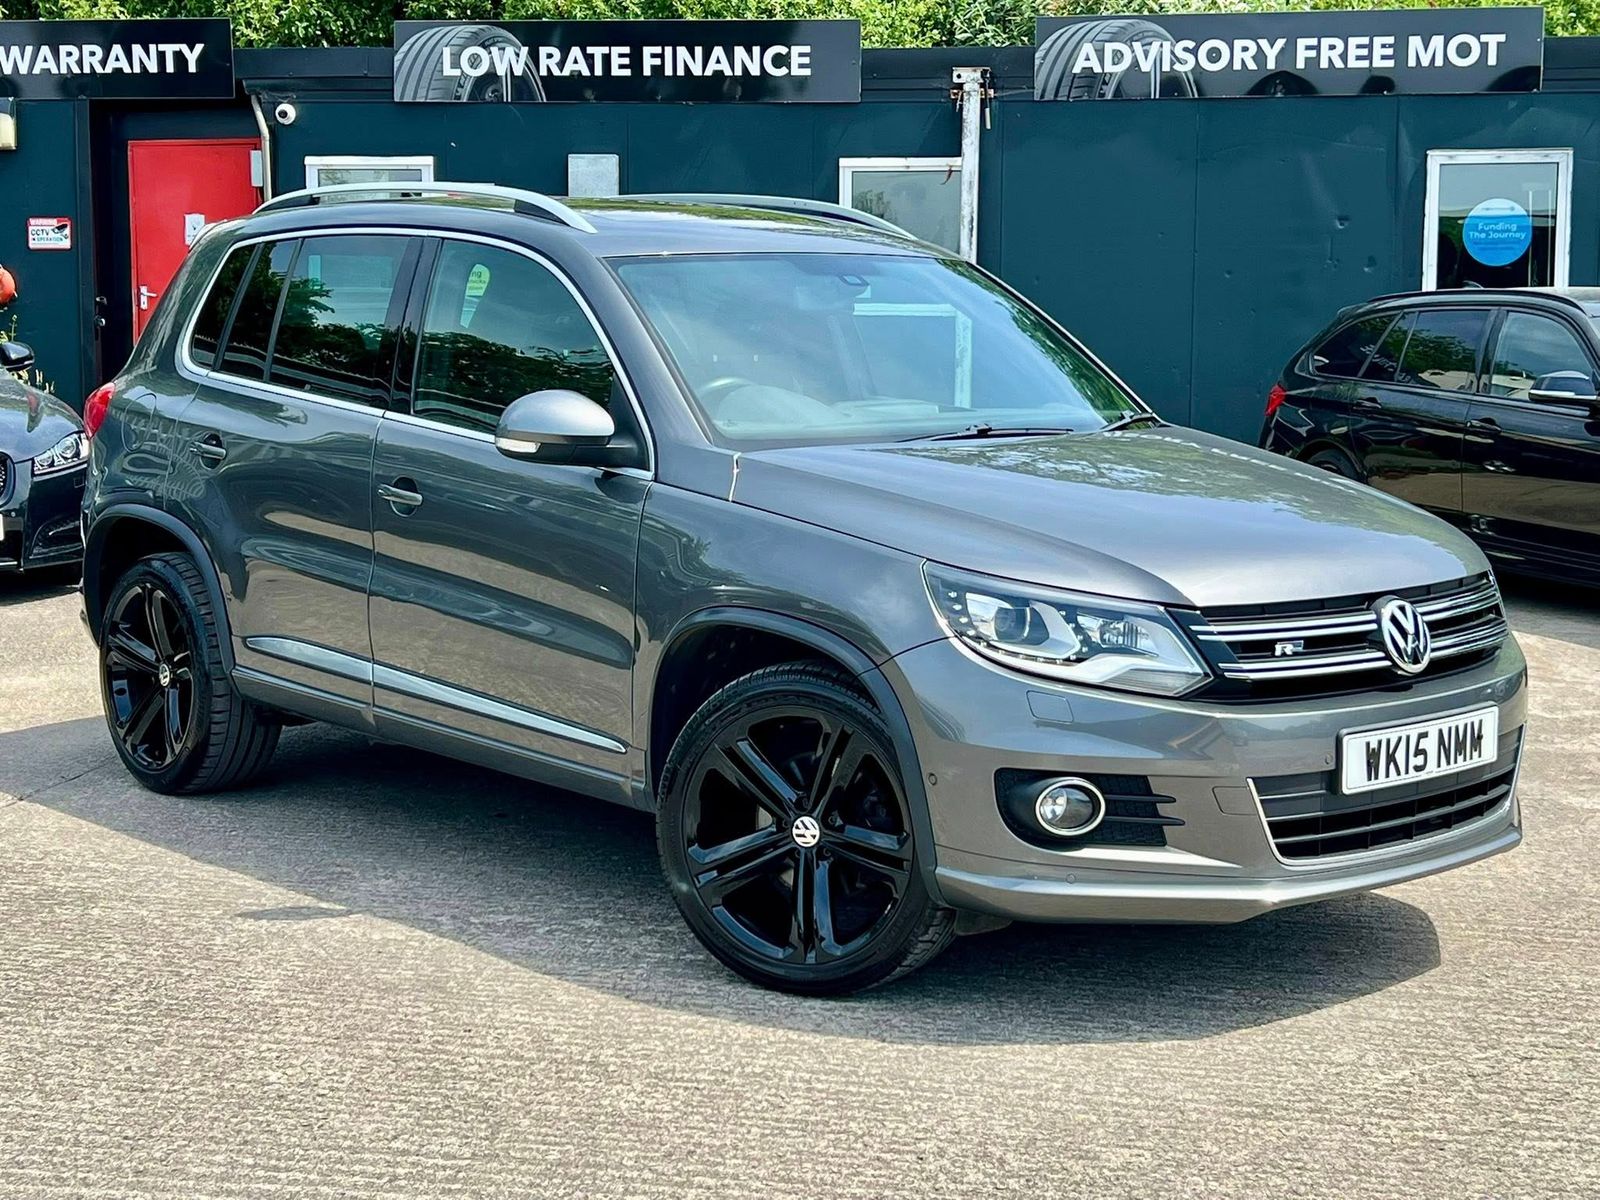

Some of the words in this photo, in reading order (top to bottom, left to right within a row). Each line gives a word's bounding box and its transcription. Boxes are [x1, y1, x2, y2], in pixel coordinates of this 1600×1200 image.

[0, 43, 204, 75] WARRANTY
[442, 46, 529, 77] LOW
[539, 46, 631, 76] RATE
[643, 46, 811, 77] FINANCE
[1073, 39, 1286, 73] ADVISORY
[1297, 37, 1395, 69] FREE
[1408, 34, 1506, 67] MOT
[1468, 231, 1486, 239] The
[1488, 231, 1526, 239] Journey
[1478, 222, 1517, 231] Funding
[1365, 732, 1429, 782] WK15
[1436, 719, 1483, 768] NMM
